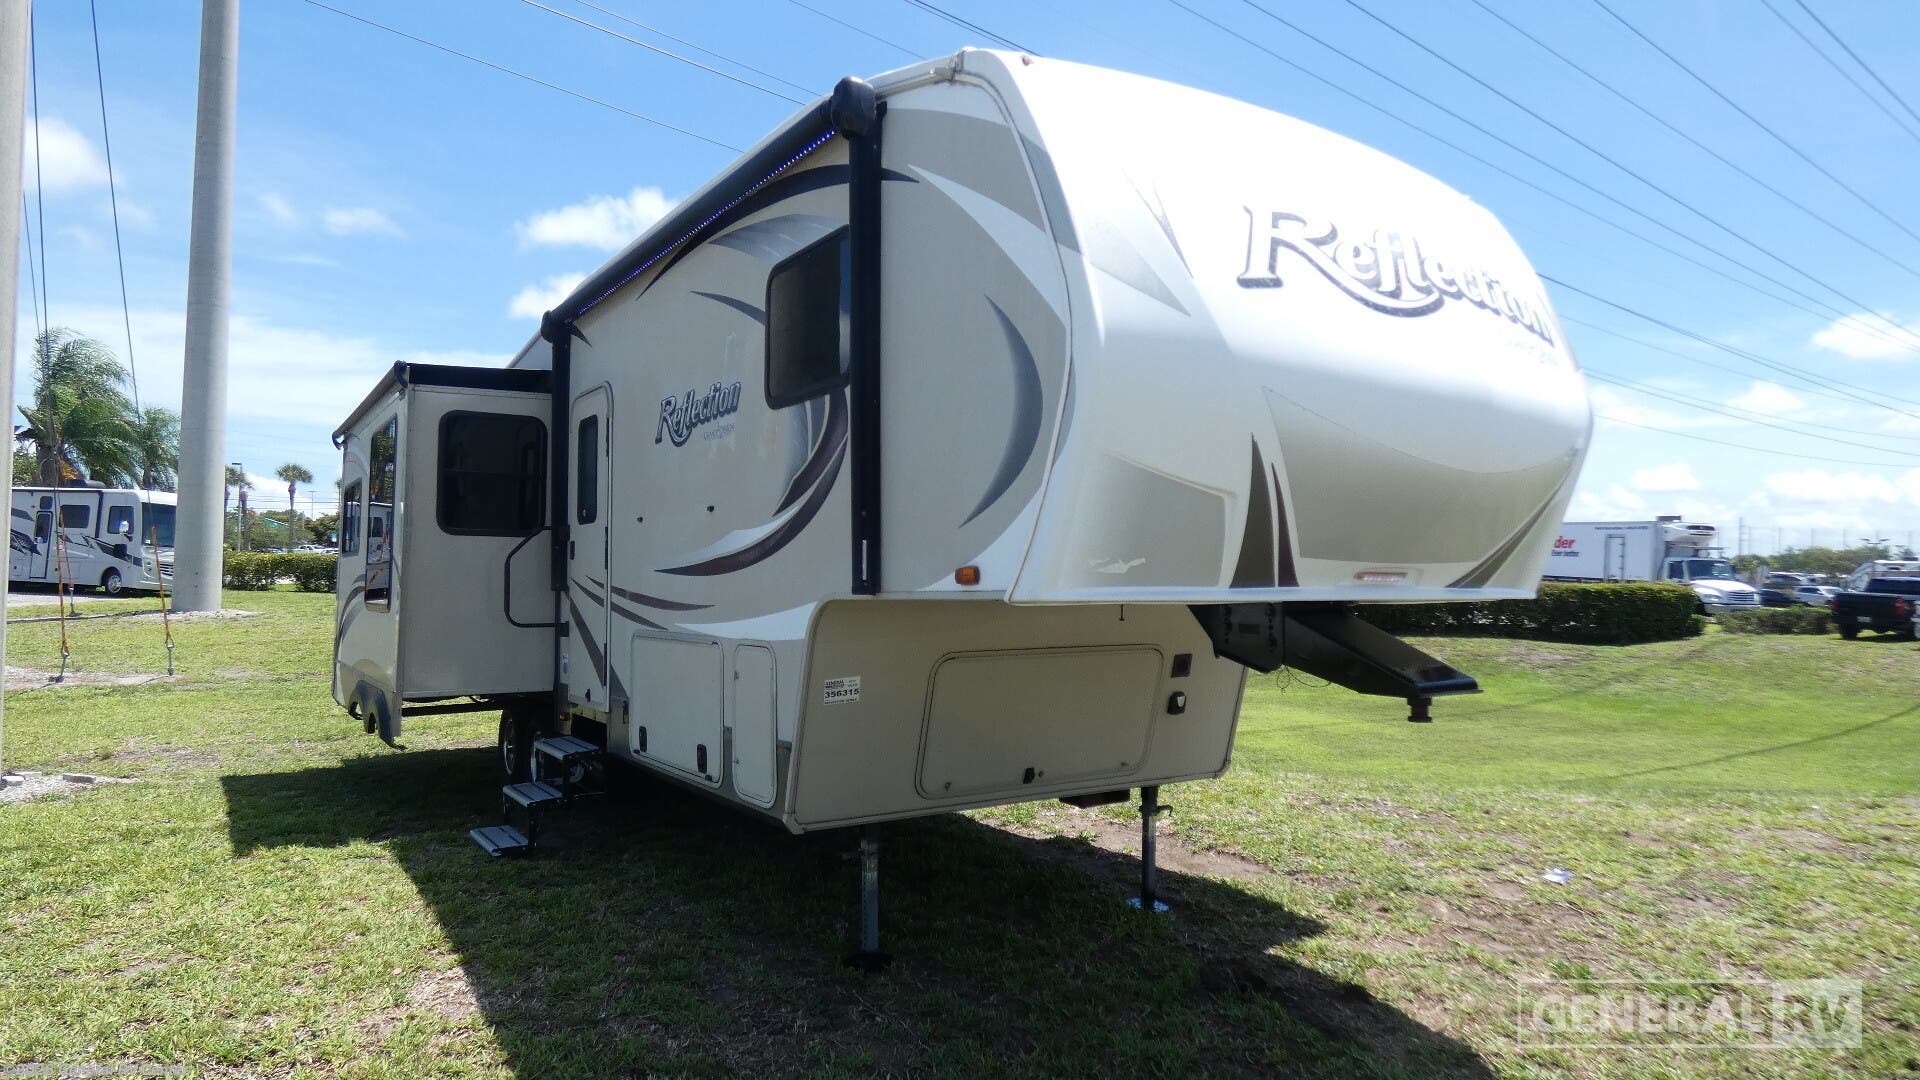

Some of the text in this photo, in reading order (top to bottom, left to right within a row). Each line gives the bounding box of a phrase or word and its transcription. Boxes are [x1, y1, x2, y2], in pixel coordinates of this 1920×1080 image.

[1236, 205, 1555, 347] Reflection
[655, 382, 741, 447] Reflection
[824, 688, 860, 699] 356315
